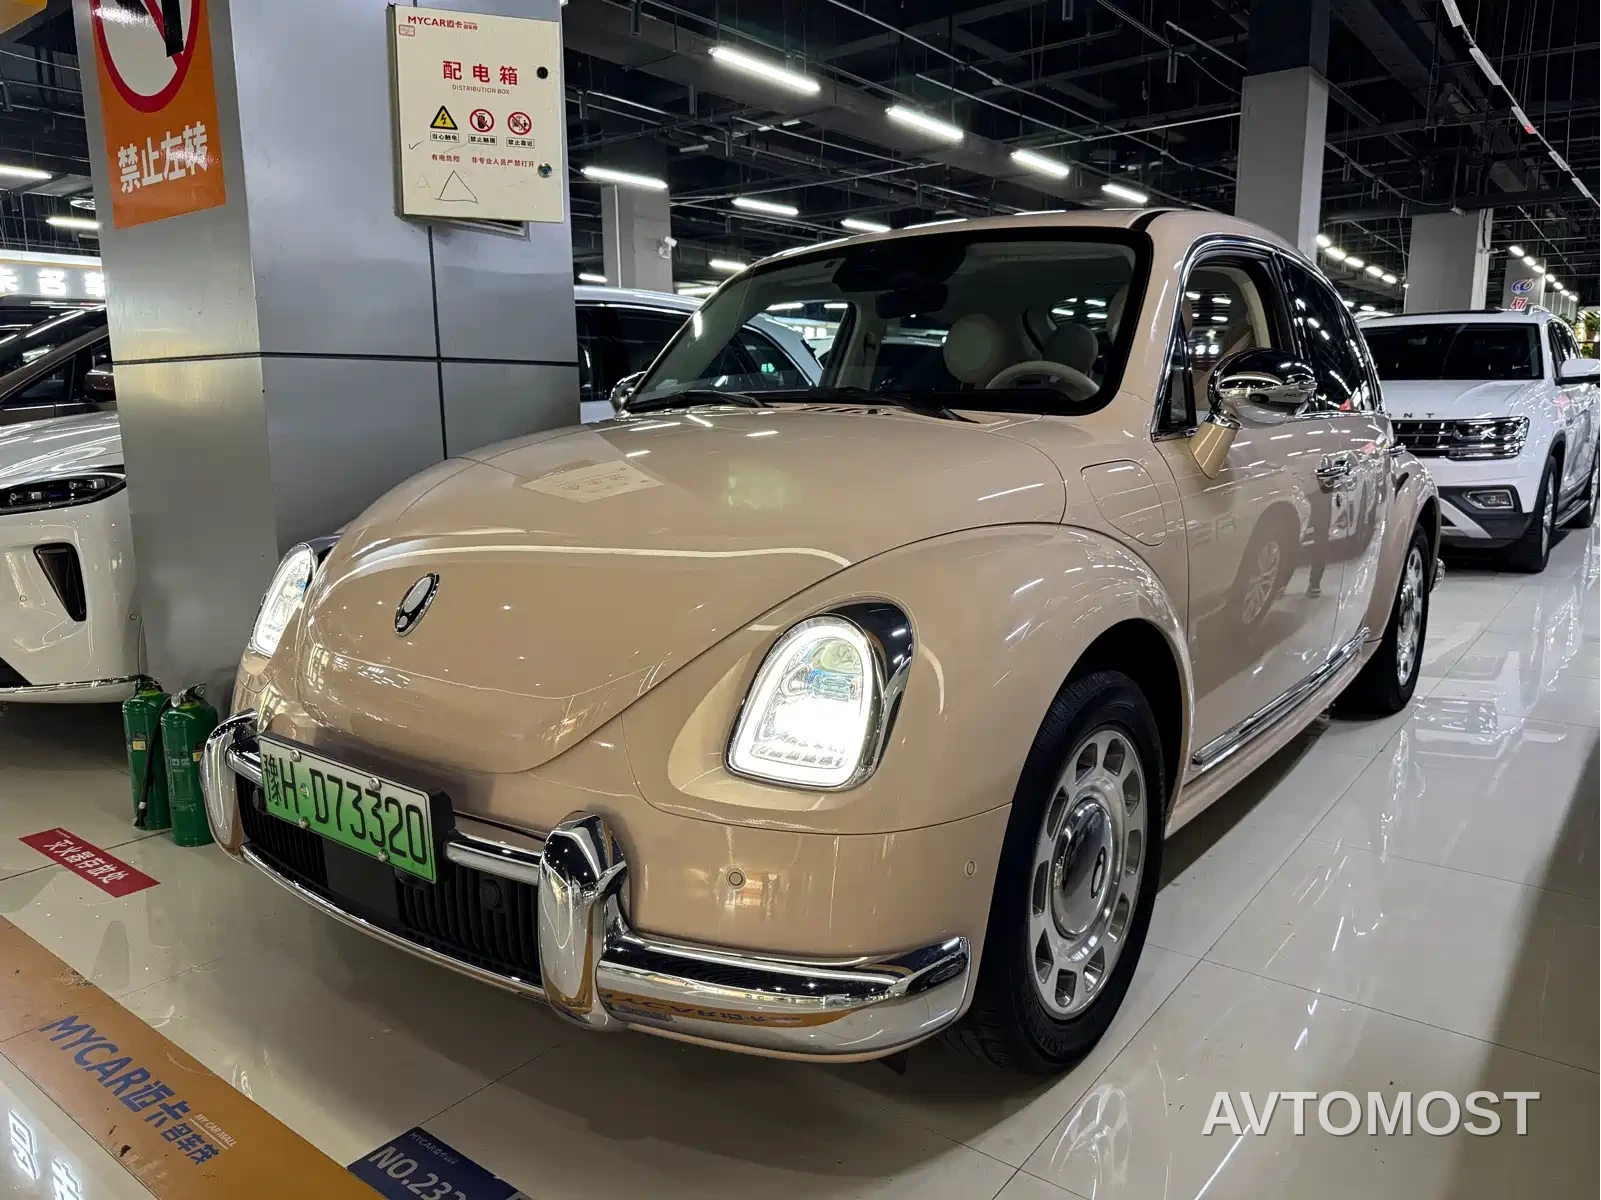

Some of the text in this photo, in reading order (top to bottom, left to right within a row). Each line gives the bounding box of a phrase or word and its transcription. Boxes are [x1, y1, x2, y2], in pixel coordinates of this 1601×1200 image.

[442, 60, 518, 86] 配电箱
[452, 84, 496, 94] DISTRIBUTION
[432, 133, 458, 141] 当心触电
[117, 121, 209, 194] 禁止左转
[431, 154, 461, 163] 有电危险
[471, 156, 535, 168] 非专业人员严禁打开
[42, 839, 130, 884] 灭火器存放处
[204, 1121, 222, 1134] CAR
[215, 1131, 238, 1148] MALL
